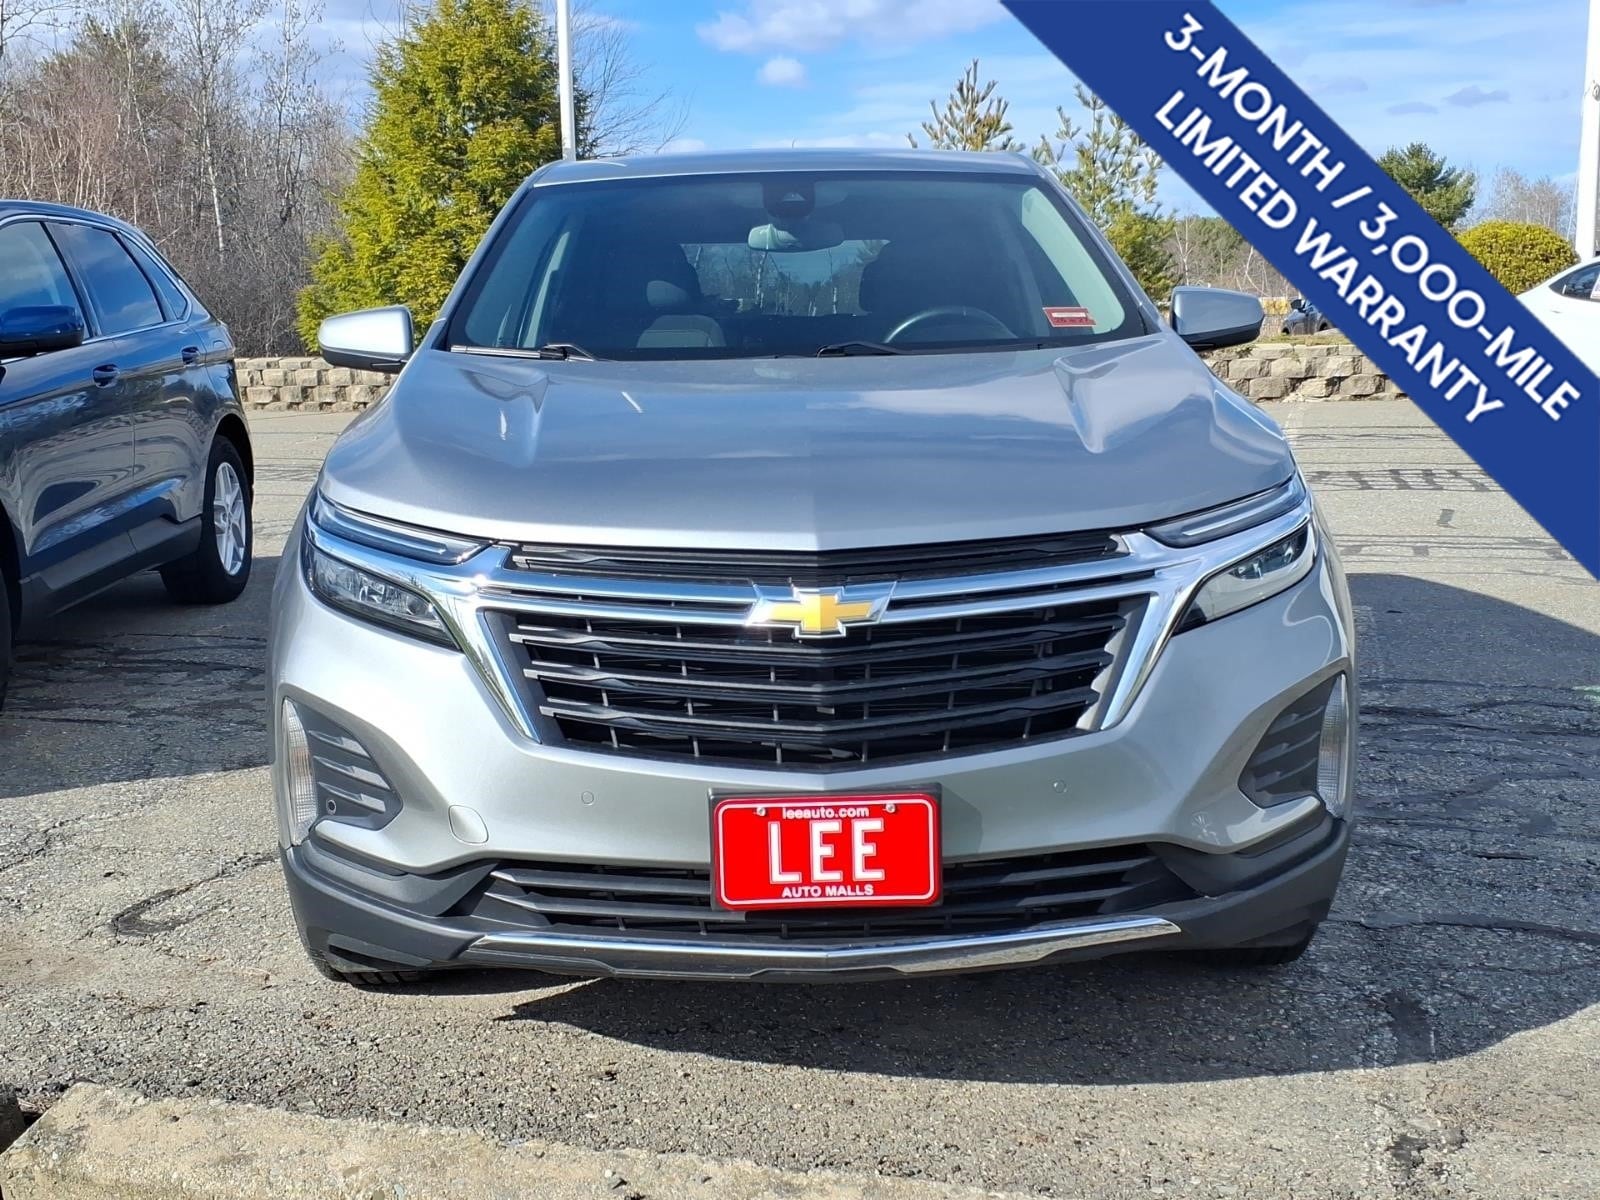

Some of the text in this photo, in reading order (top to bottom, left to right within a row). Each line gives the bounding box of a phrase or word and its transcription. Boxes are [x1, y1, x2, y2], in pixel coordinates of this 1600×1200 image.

[782, 807, 869, 818] leeauto.com
[769, 819, 885, 884] LEE
[782, 885, 874, 898] AUTO MALLS
